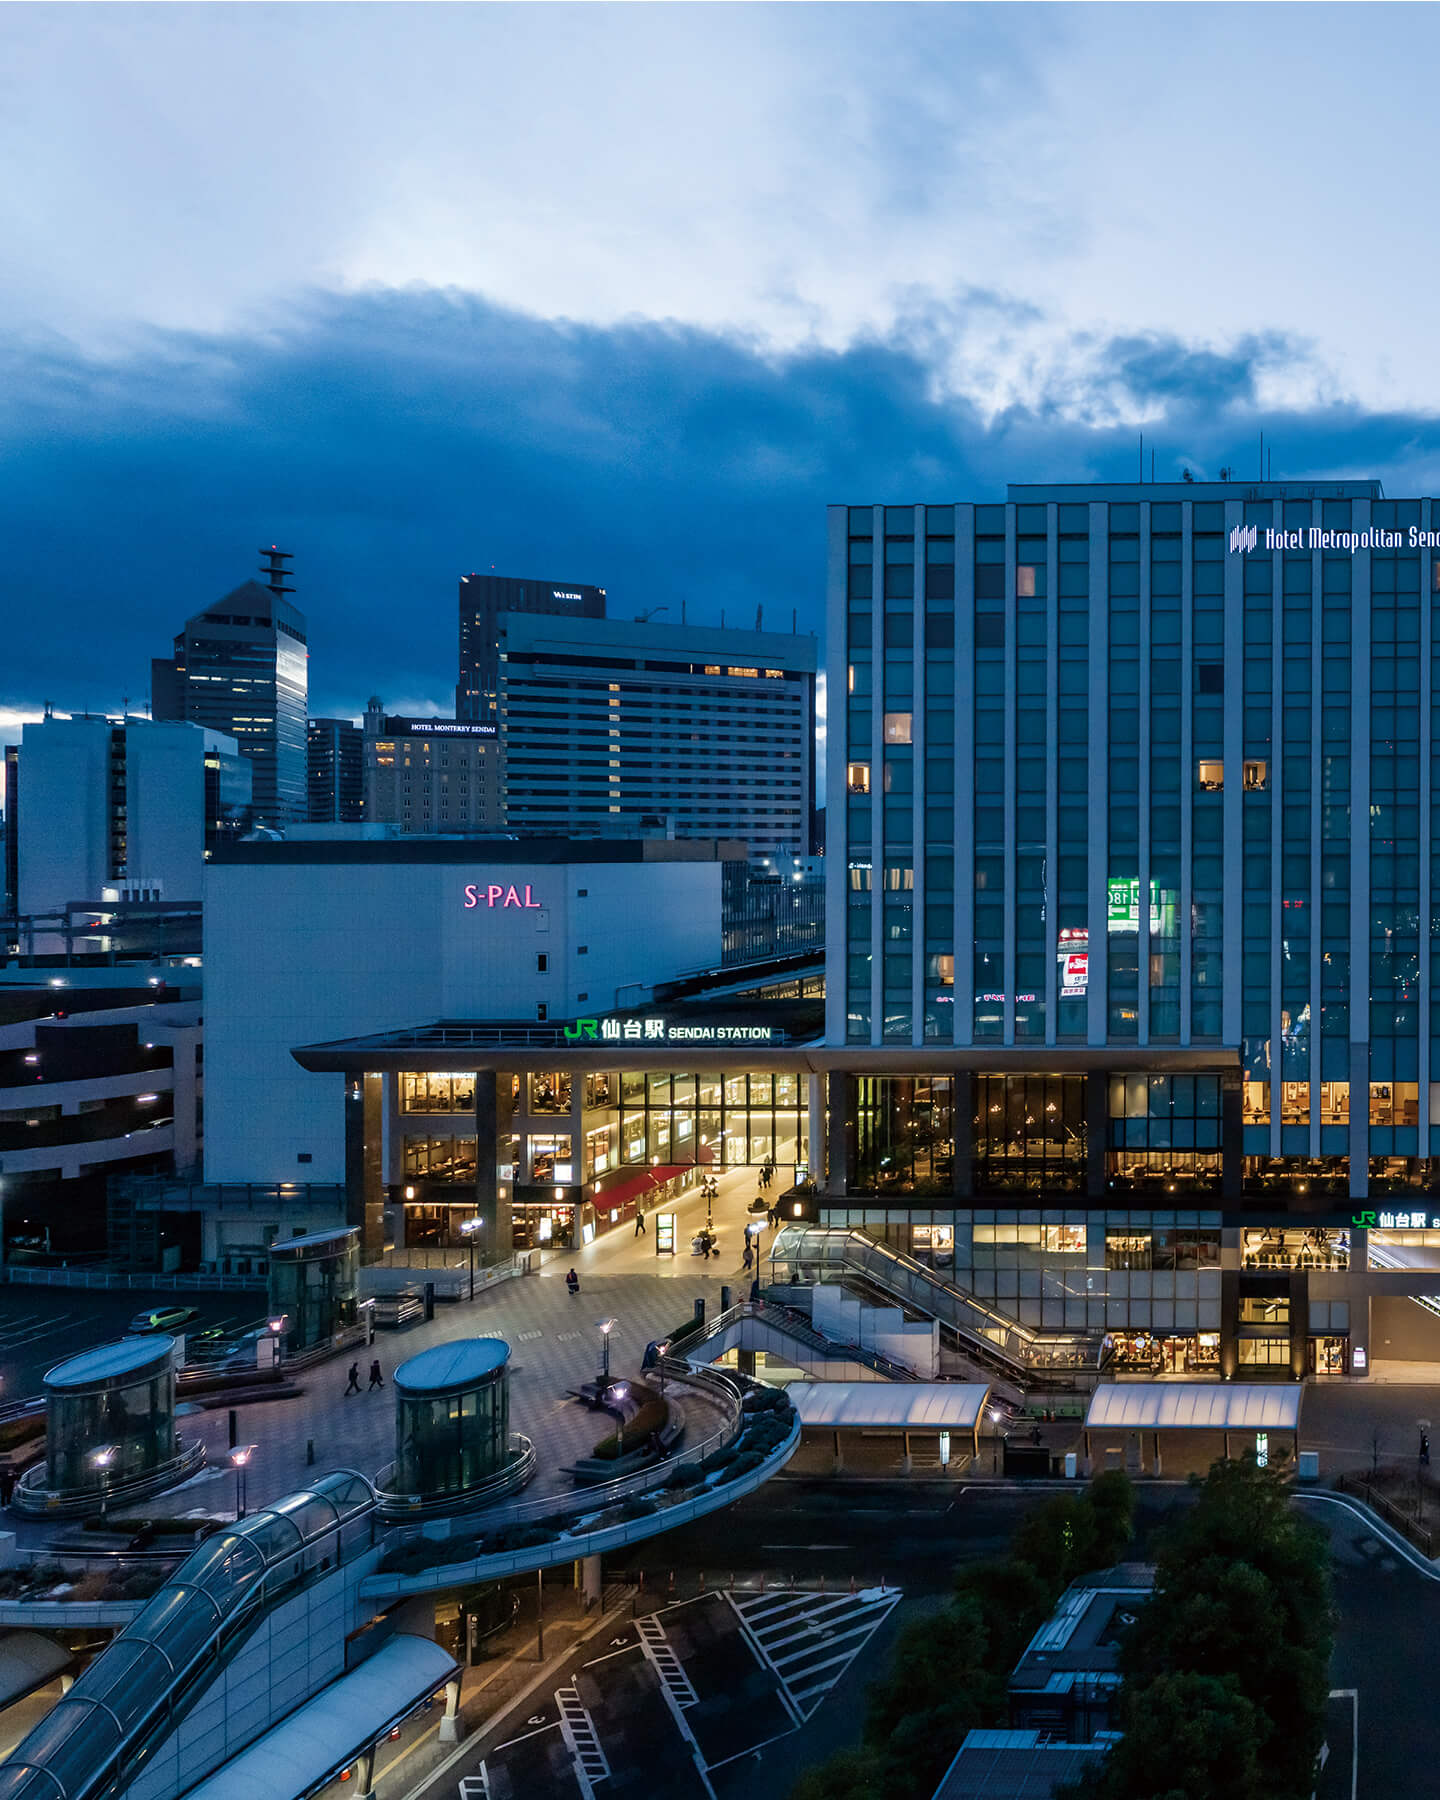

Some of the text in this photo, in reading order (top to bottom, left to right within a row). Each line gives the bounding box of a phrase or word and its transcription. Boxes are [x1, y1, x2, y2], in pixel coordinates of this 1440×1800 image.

[1266, 528, 1304, 550] Hotel
[1309, 526, 1402, 554] Metropolitan
[411, 724, 496, 734] HOTEL MONTEREY SENDAI
[464, 885, 541, 908] S-PAL
[564, 1019, 771, 1039] JR 仙台駅 SENDAI STATION
[1352, 1211, 1377, 1228] JR
[1379, 1212, 1426, 1228] 仙台駅
